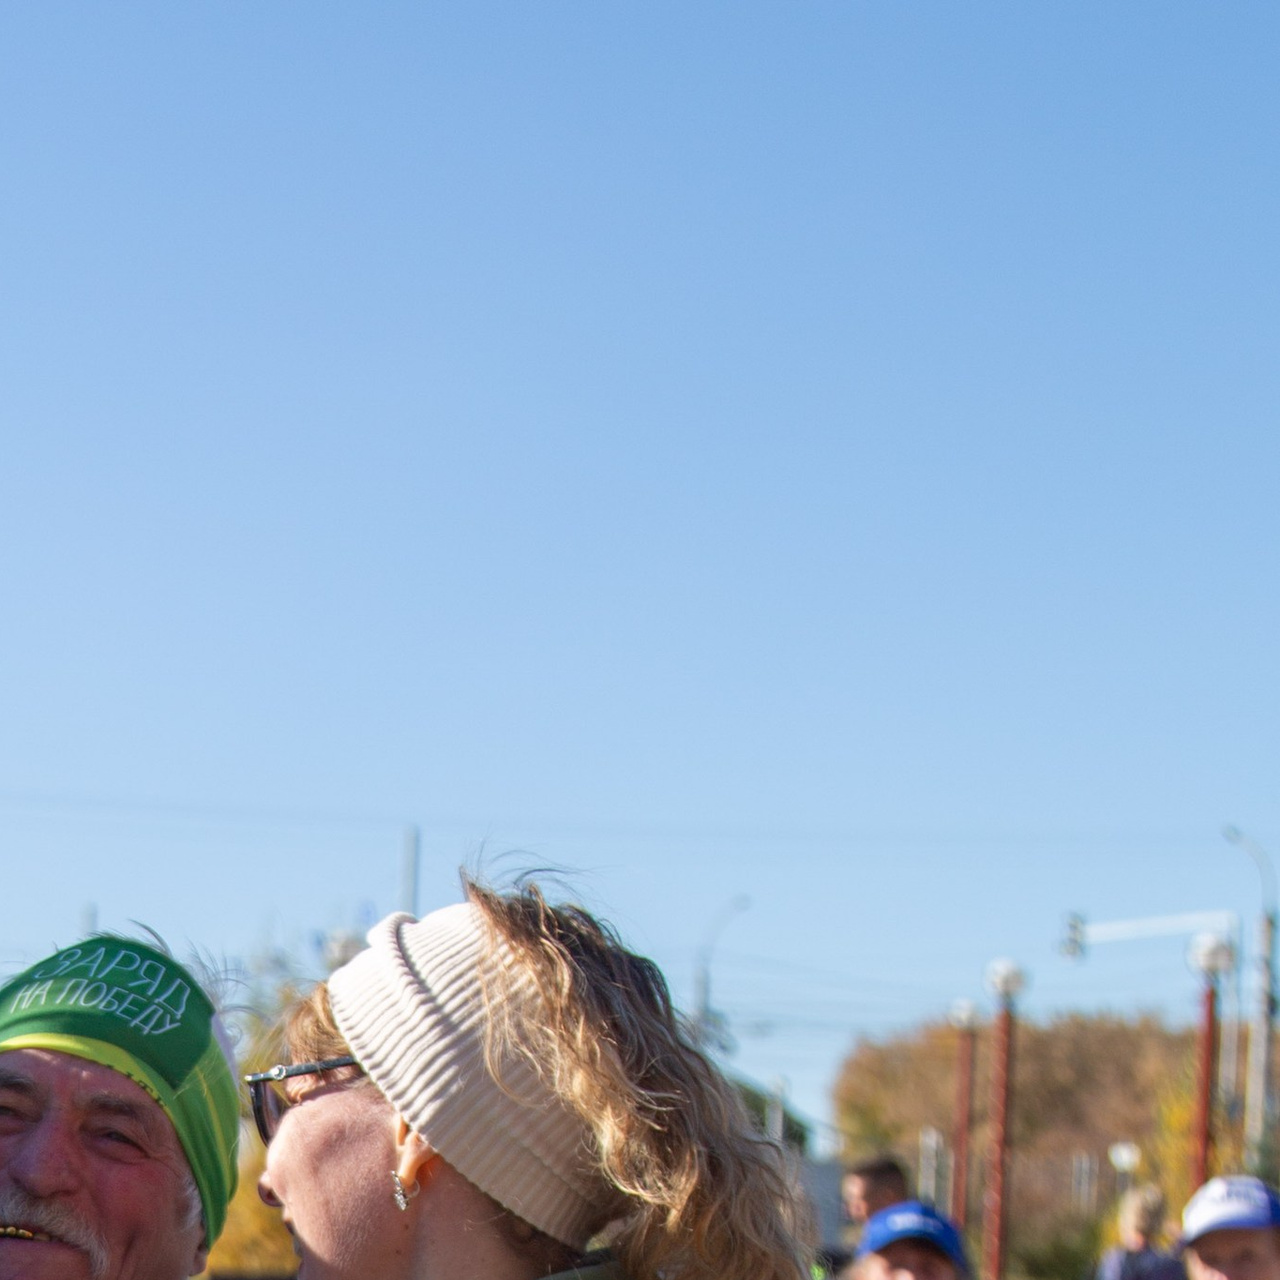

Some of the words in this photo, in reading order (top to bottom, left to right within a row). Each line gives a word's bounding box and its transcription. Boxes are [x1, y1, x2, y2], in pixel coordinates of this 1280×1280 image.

[9, 979, 55, 1014] НА
[55, 978, 182, 1035] ПОБЕДУ
[34, 947, 191, 1020] ЗАРЯД
